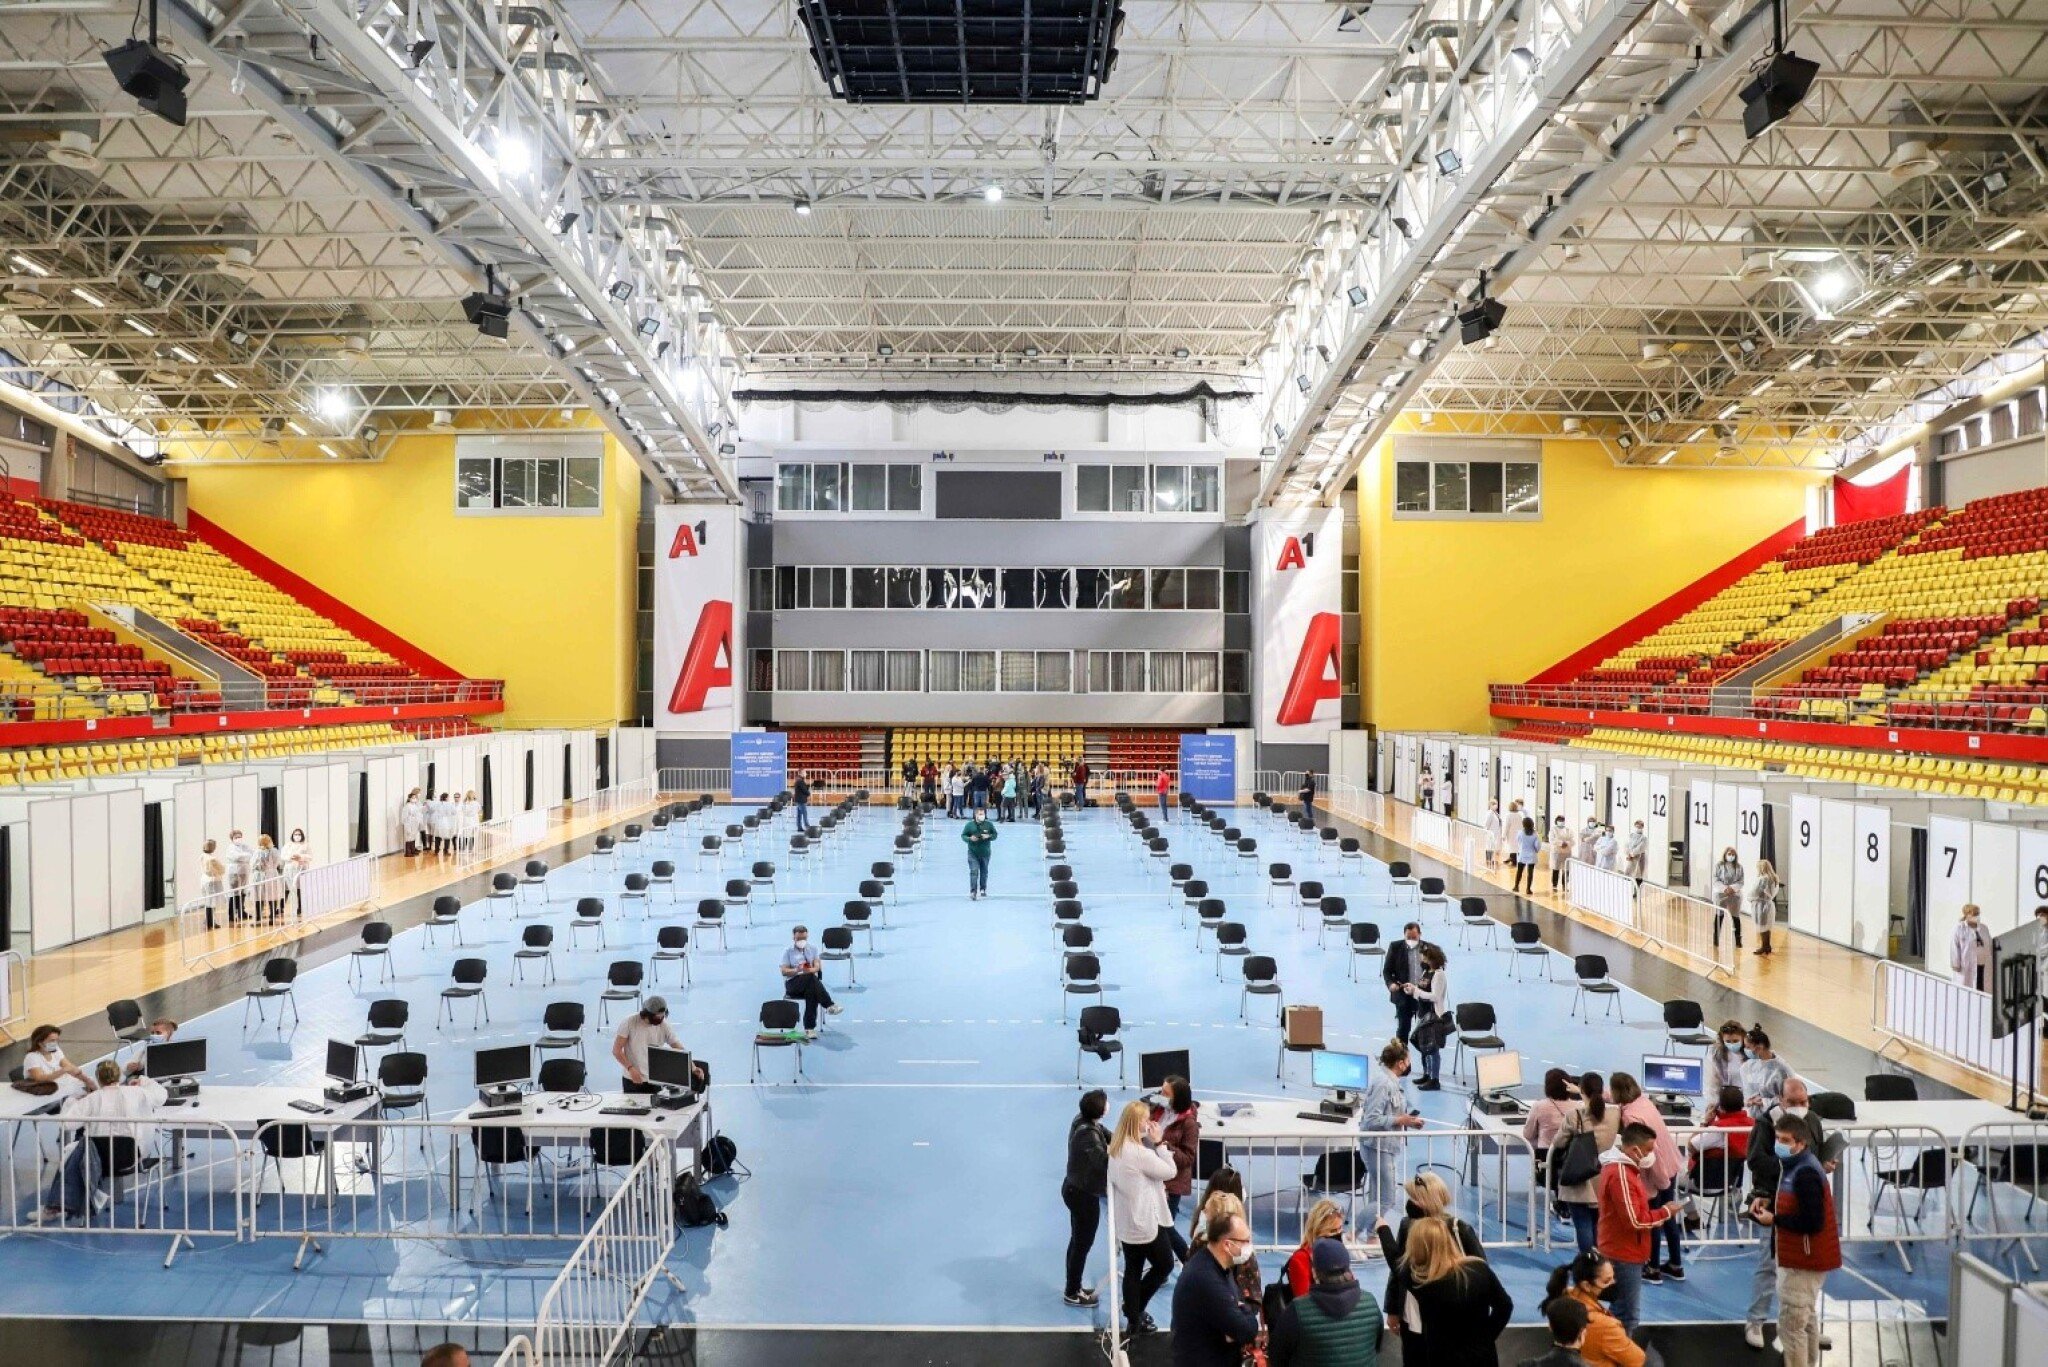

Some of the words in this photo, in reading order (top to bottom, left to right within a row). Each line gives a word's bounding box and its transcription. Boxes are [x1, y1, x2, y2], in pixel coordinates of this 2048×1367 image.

[669, 520, 707, 558] A1
[1277, 532, 1314, 570] A1
[1460, 758, 1468, 774] 19
[1481, 762, 1489, 778] 18
[1503, 766, 1511, 782] 17
[1527, 770, 1536, 788] 16
[1552, 775, 1563, 795] 15
[1583, 781, 1594, 801] 14
[1616, 787, 1629, 809] 13
[1652, 794, 1666, 817] 12
[1694, 802, 1709, 826] 11
[1741, 810, 1760, 837] 10
[1800, 820, 1811, 847] 9
[1866, 832, 1879, 862] 8
[1943, 846, 1958, 878] 7
[2035, 864, 2048, 899] 6
